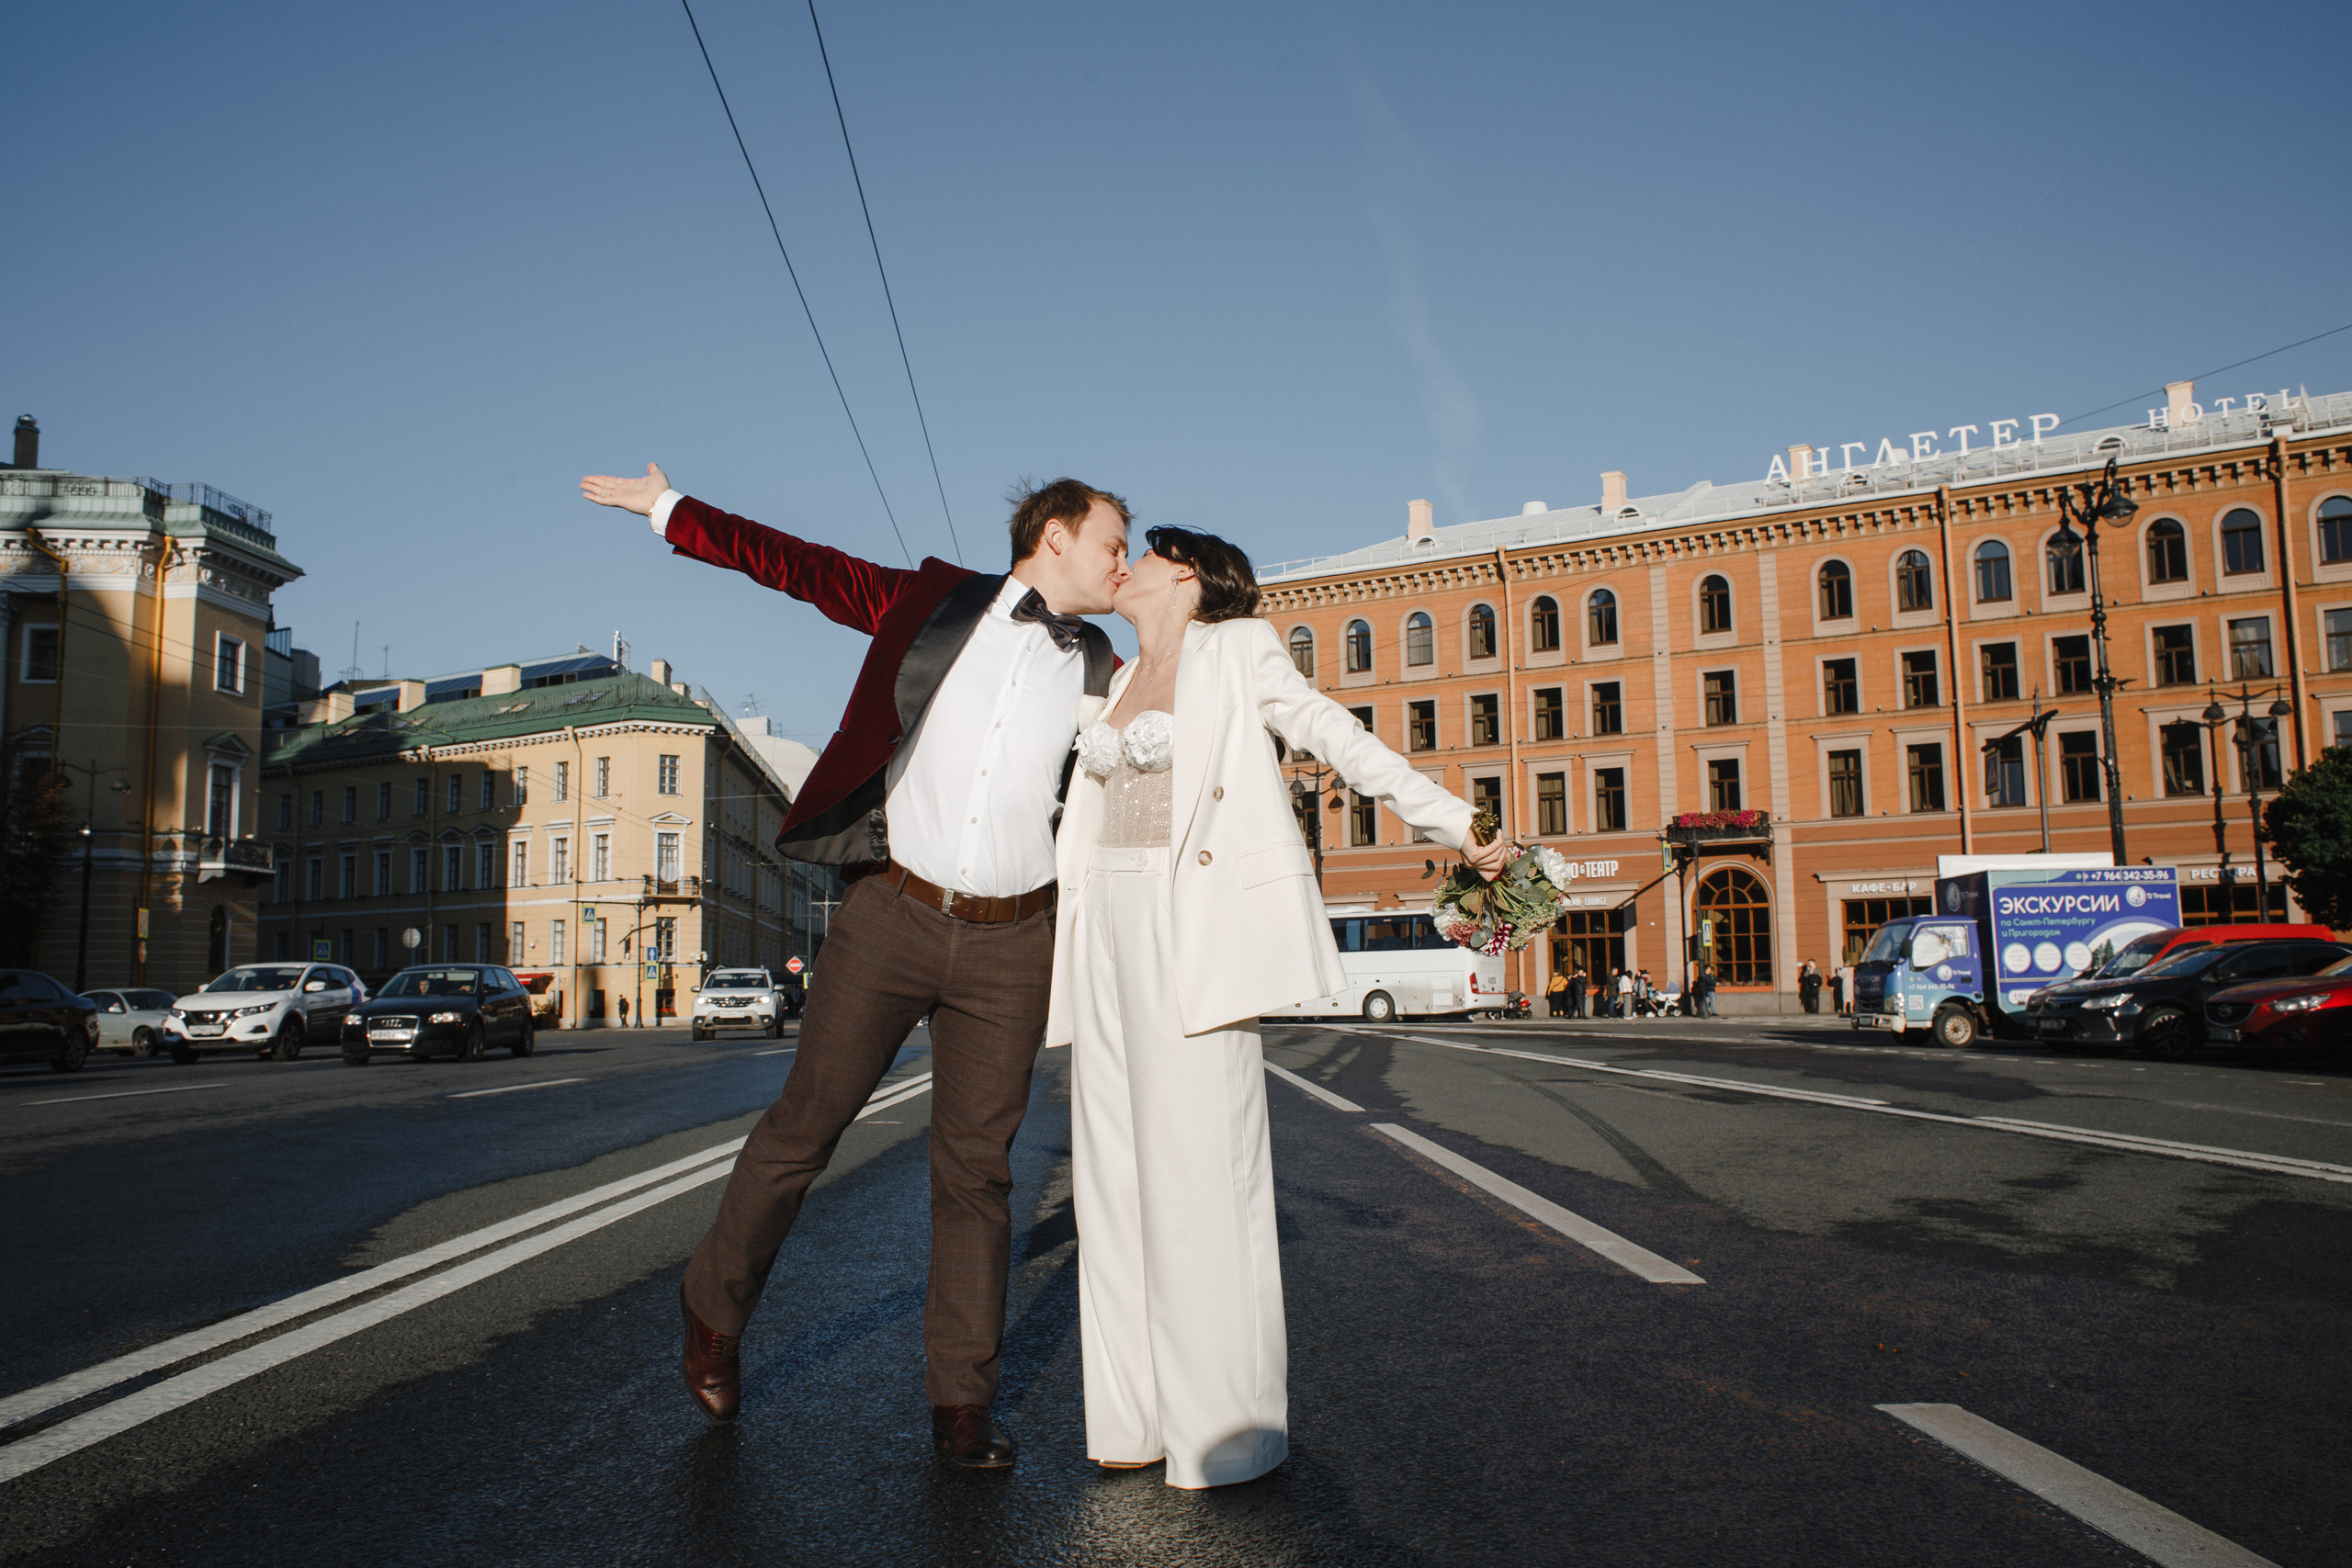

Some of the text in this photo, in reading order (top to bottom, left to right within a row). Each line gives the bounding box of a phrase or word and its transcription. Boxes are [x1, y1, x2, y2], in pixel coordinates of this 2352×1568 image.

[2147, 389, 2300, 429] HOTEL
[1763, 413, 2060, 485] АНГЛЕТЕР
[2090, 870, 2169, 881] +7 964 342-35-96
[2190, 866, 2257, 880] РЕСТОРА
[1584, 897, 1607, 907] LOUNGE
[1998, 894, 2120, 915] ЭКСКУРСИИ
[2013, 917, 2096, 927] Санкт-Петербургу
[2008, 929, 2061, 938] Пригородам
